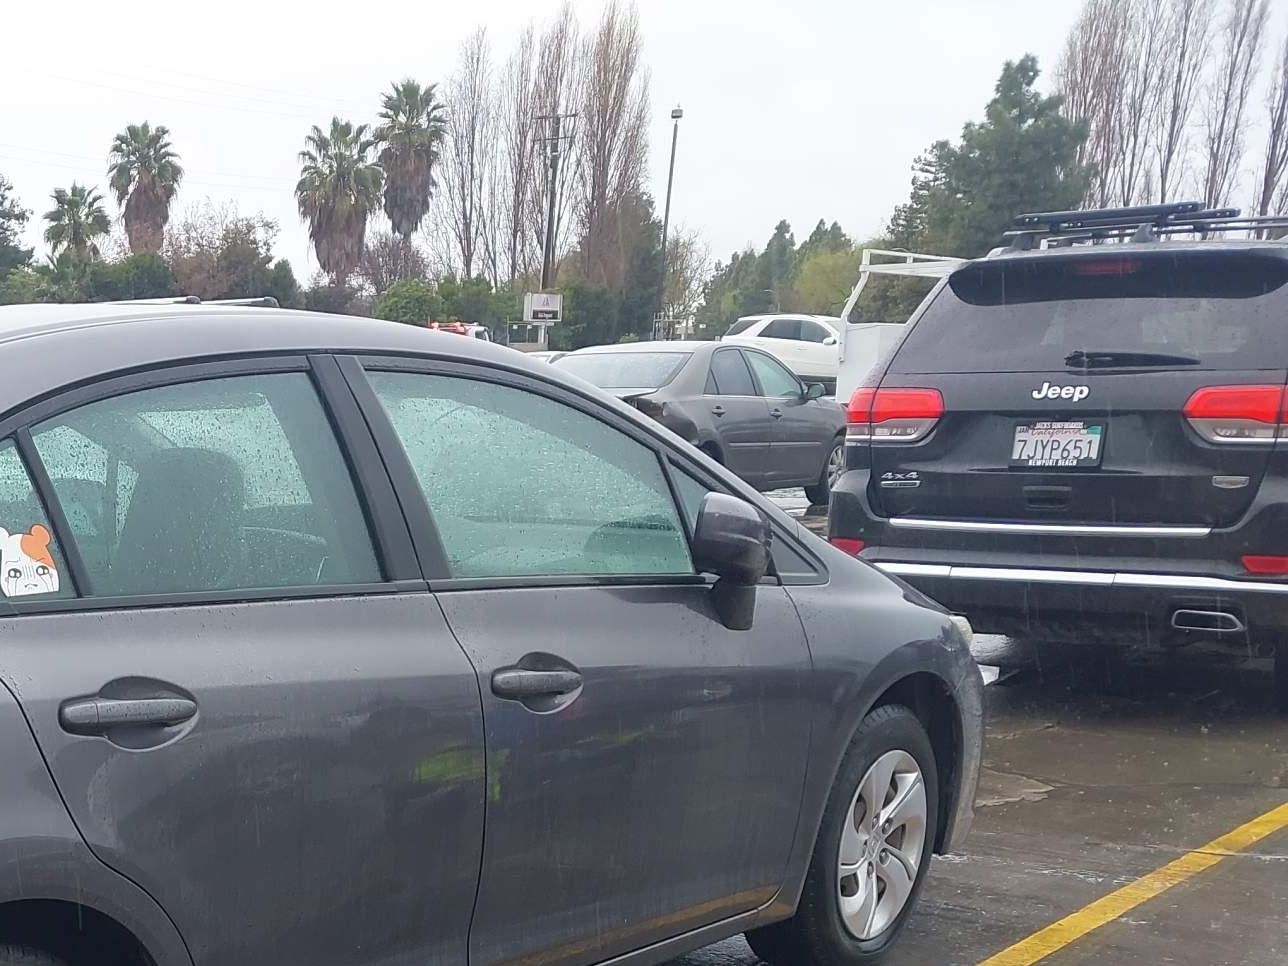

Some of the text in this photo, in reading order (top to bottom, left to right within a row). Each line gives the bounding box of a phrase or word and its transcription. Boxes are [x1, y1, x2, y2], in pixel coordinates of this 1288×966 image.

[1032, 382, 1089, 402] Jeep
[1016, 439, 1093, 460] 7JYP651
[881, 471, 919, 480] 4x4
